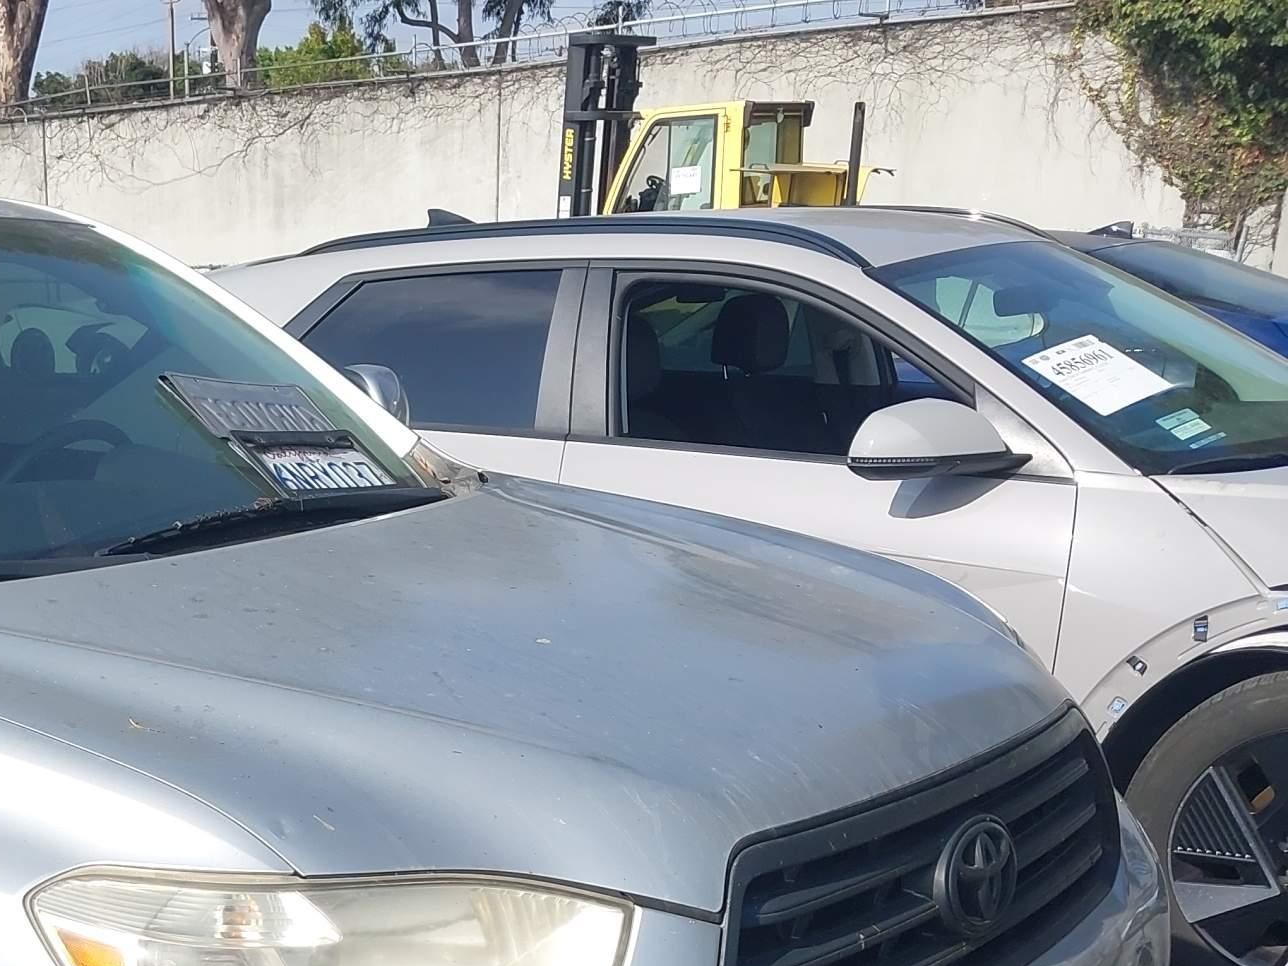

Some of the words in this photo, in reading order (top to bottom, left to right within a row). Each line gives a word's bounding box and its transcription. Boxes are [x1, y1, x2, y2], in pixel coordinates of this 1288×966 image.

[562, 128, 575, 180] HYSTER
[1052, 348, 1115, 377] 45856961
[271, 461, 384, 490] 6NRY037
